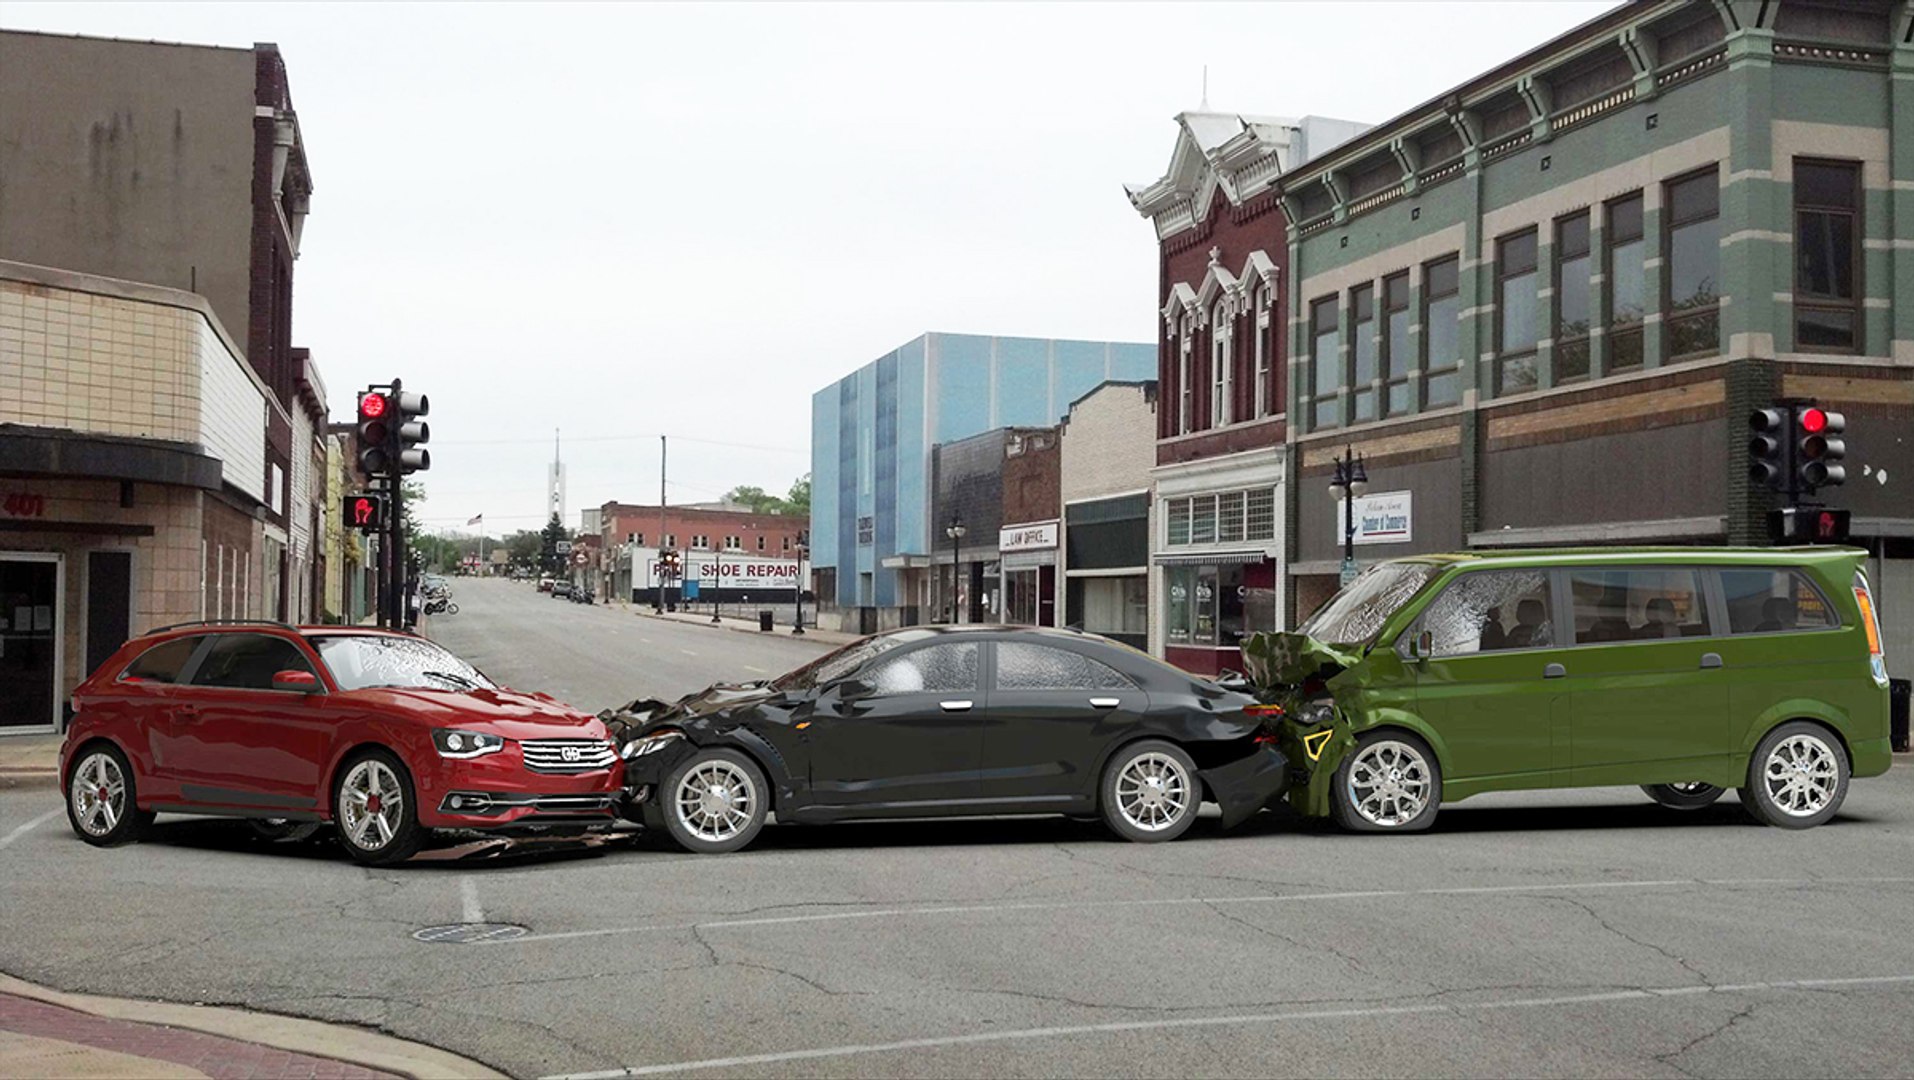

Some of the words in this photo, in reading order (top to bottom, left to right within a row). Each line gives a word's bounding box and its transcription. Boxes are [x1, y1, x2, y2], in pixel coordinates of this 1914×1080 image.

[3, 493, 43, 516] 401
[701, 564, 741, 577] SHOE
[746, 564, 798, 577] REPAIR
